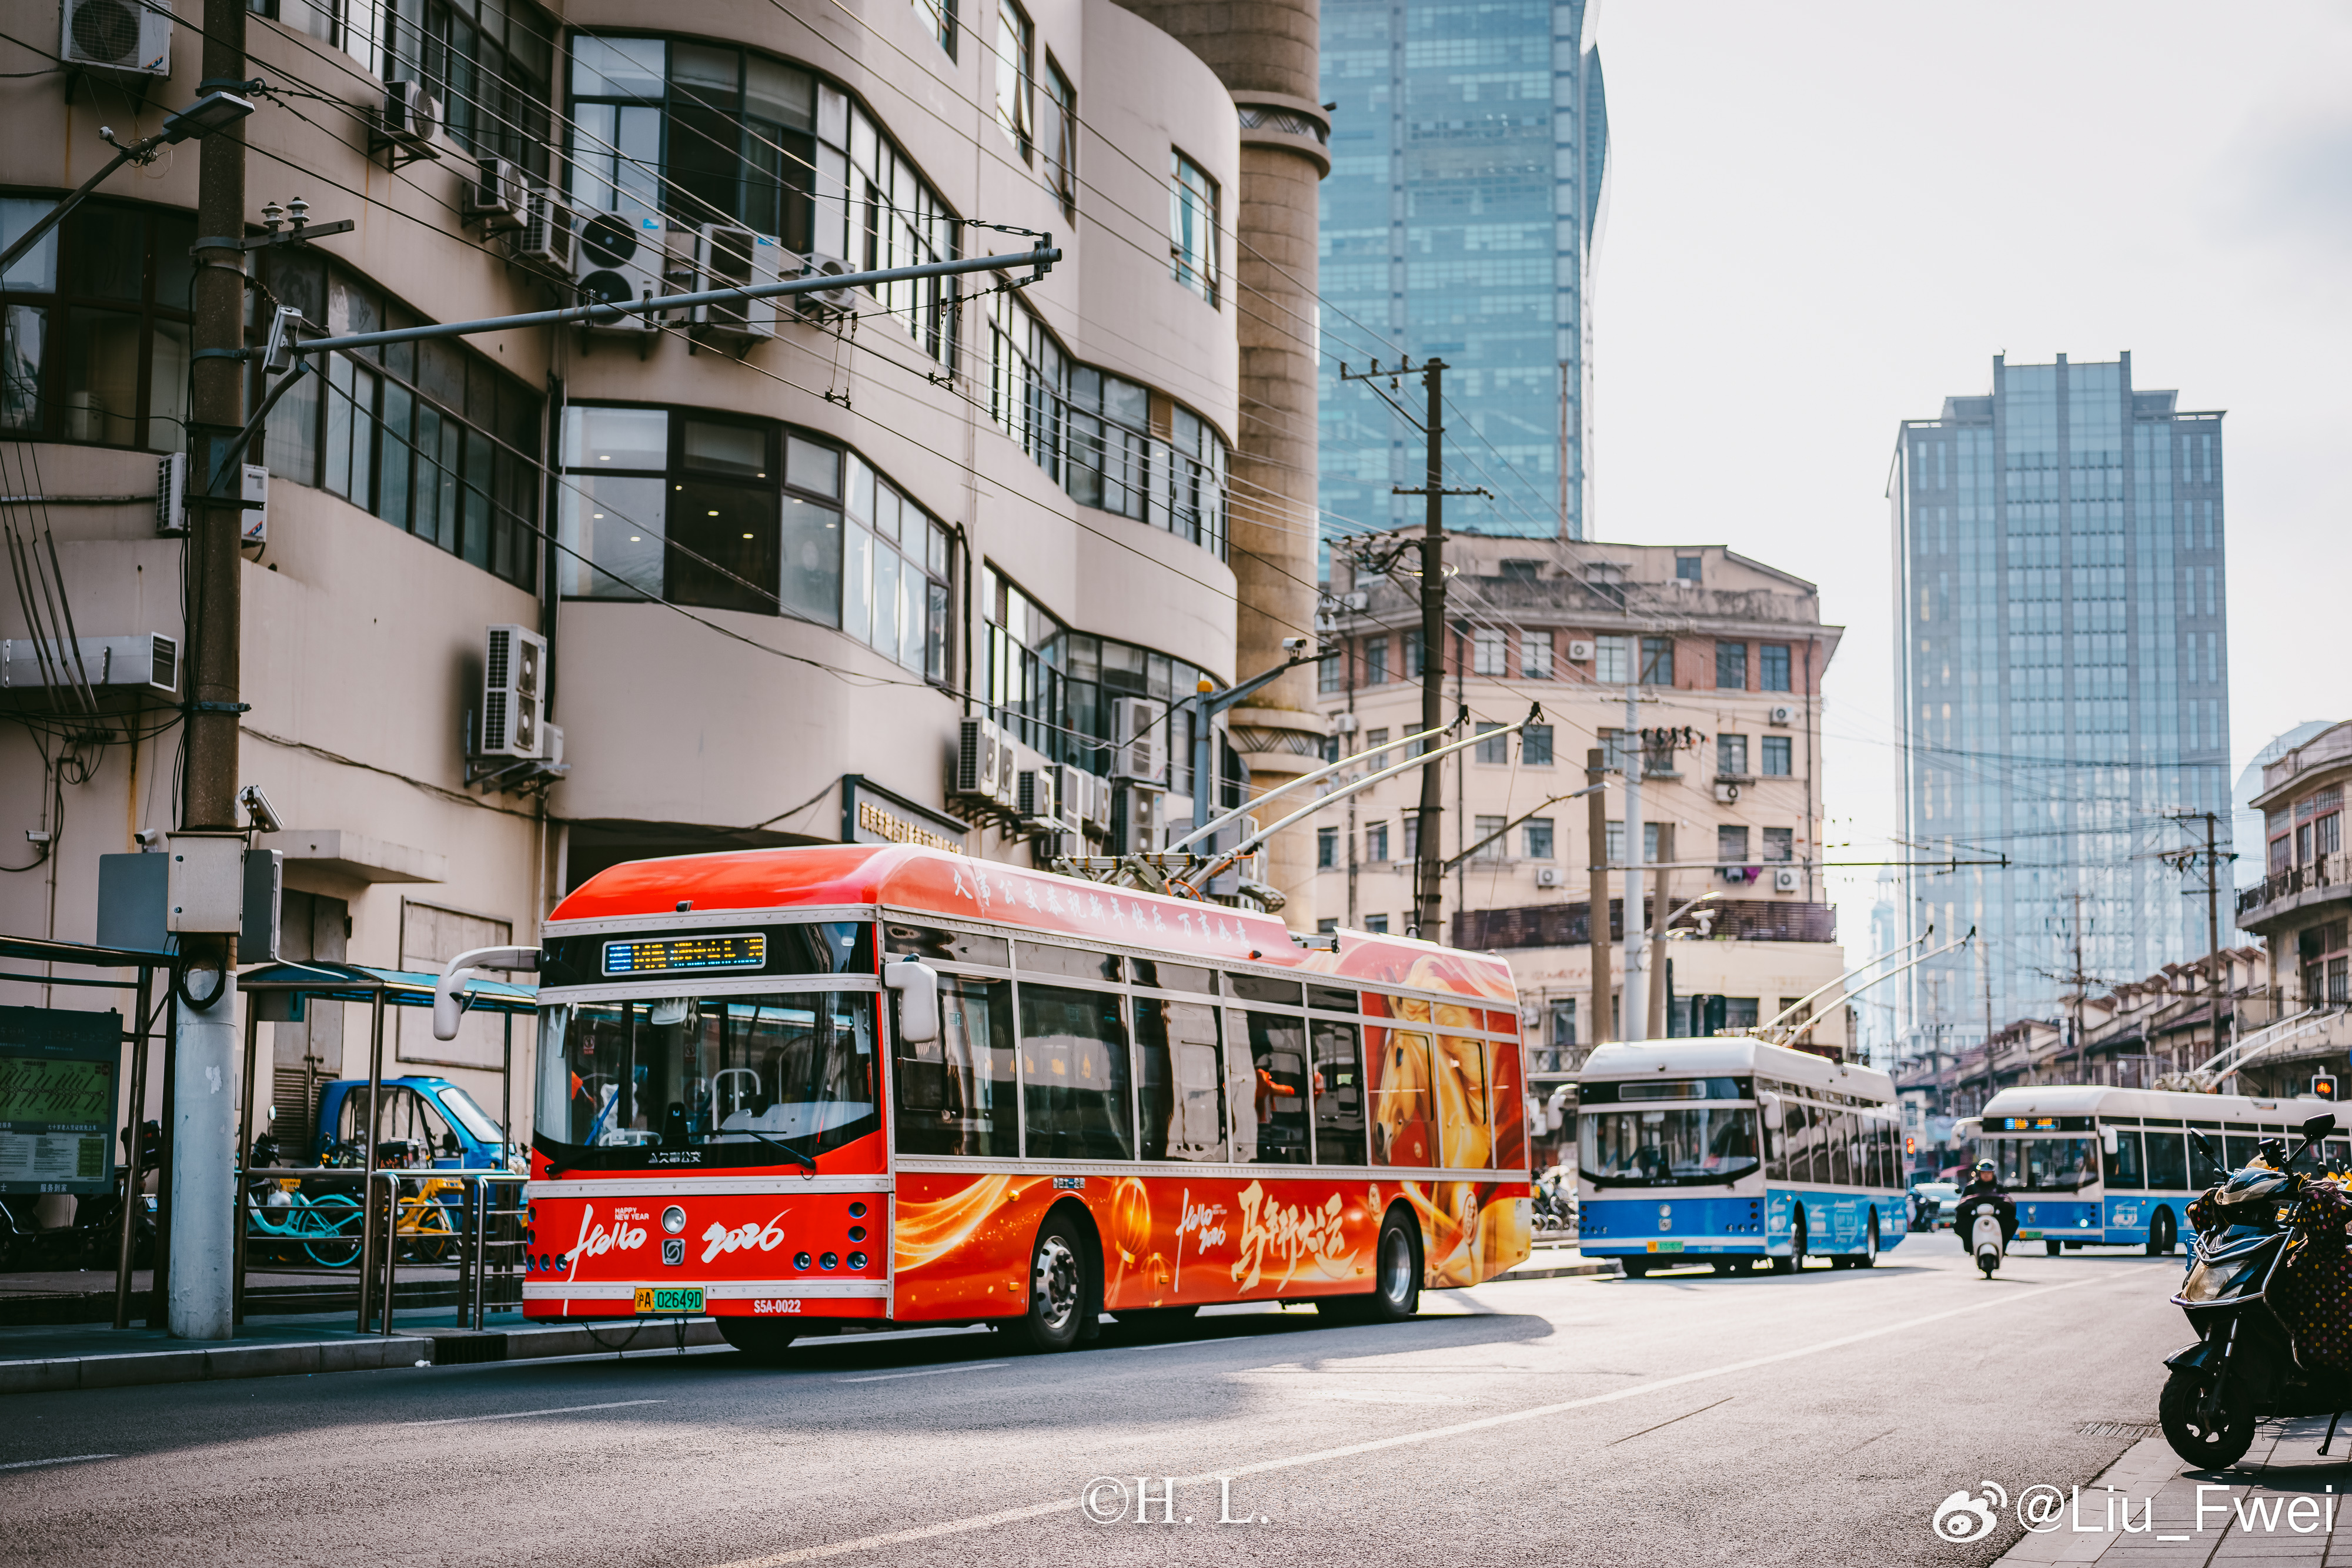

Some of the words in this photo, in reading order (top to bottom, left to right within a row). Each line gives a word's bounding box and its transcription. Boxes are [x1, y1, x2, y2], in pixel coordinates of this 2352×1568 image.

[40, 1183, 68, 1193] 服务到家
[566, 1203, 647, 1283] Hello
[700, 1207, 793, 1263] 2026
[1174, 1187, 1214, 1292] Hello
[1198, 1217, 1227, 1255] 2026
[636, 1291, 652, 1308] 沪A
[656, 1291, 703, 1308] 02649D
[753, 1299, 802, 1313] S5A-0022
